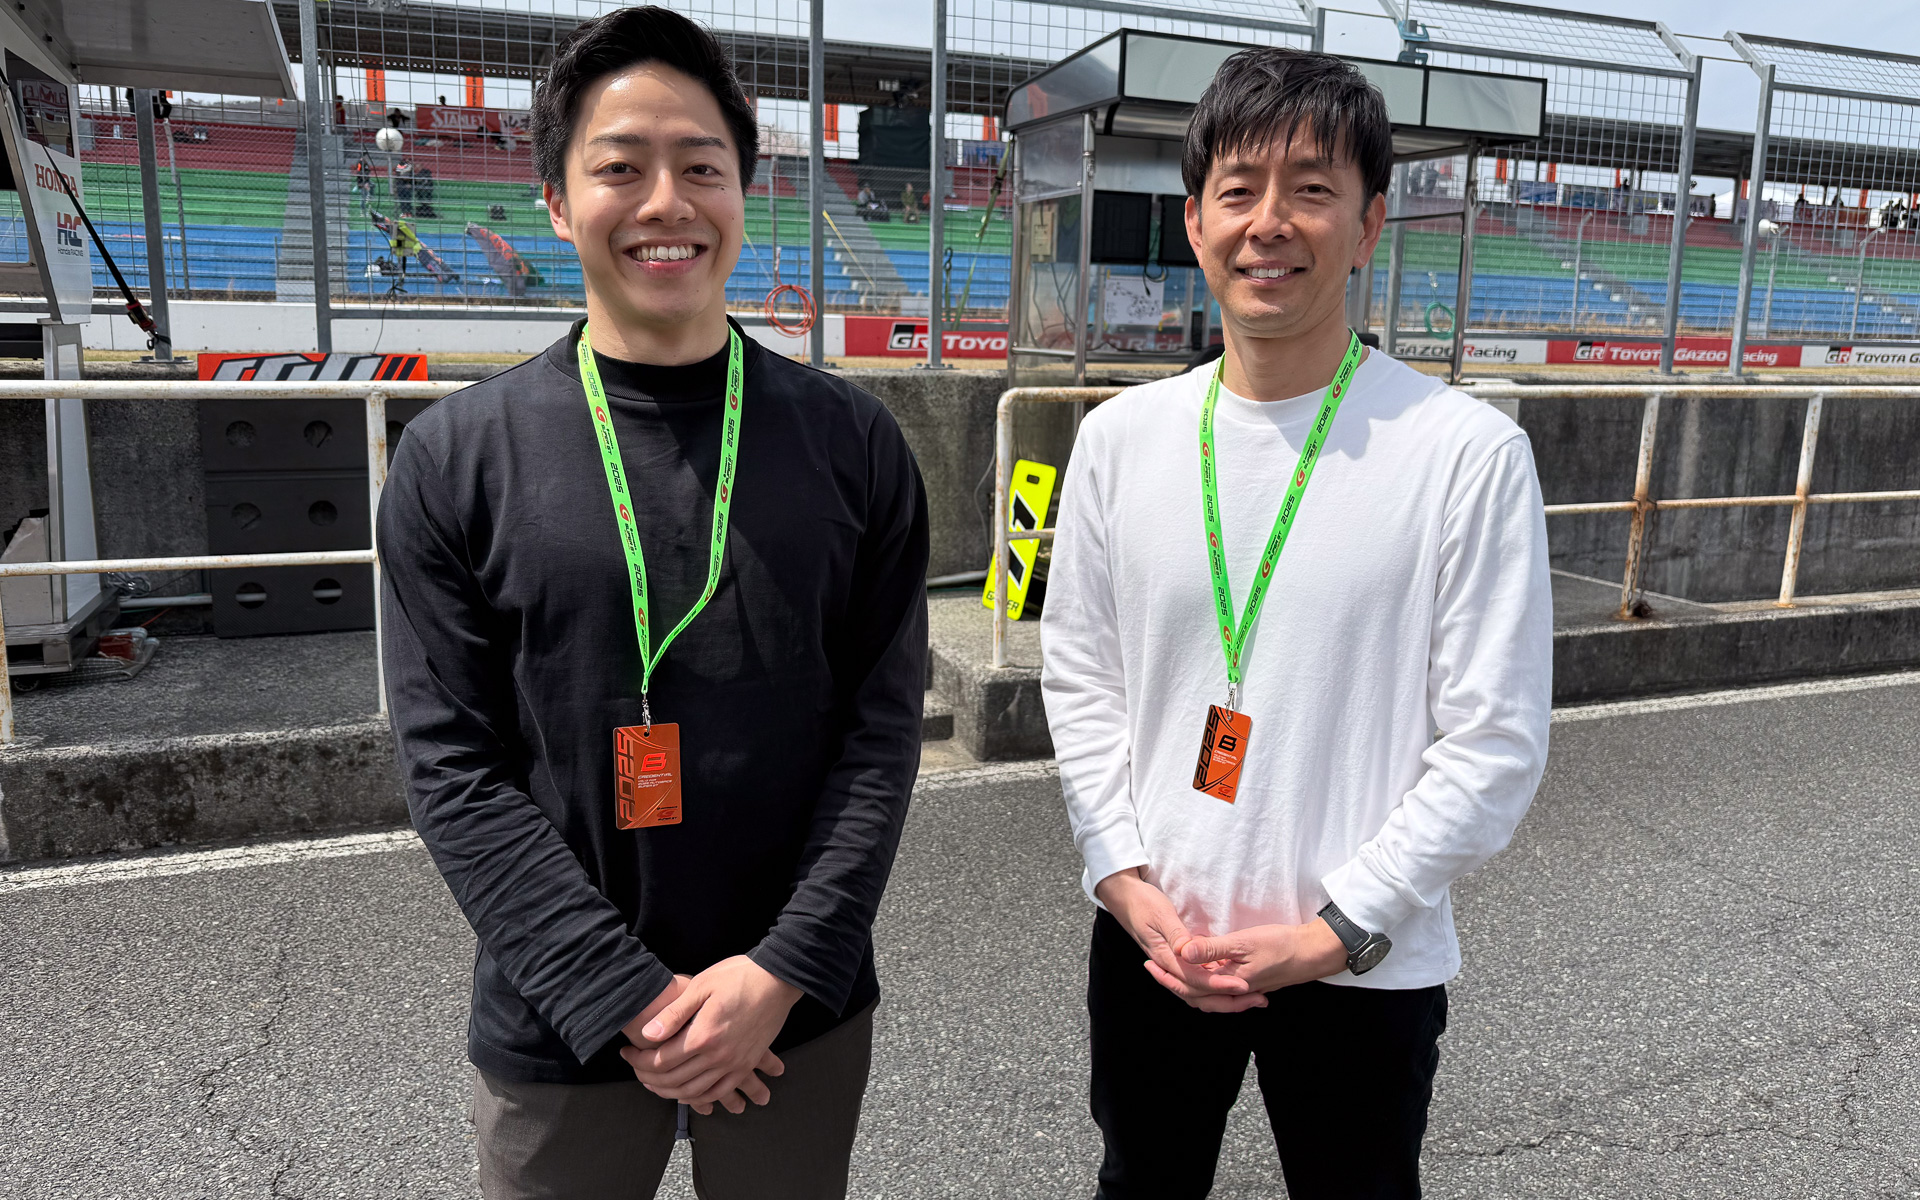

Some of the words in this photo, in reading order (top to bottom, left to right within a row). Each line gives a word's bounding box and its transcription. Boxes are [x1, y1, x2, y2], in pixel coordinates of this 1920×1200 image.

[431, 108, 484, 127] STANLEY
[34, 163, 79, 198] HONDA
[56, 211, 82, 247] HRC
[890, 334, 928, 349] GR
[943, 335, 1007, 350] TOYO
[1463, 345, 1517, 362] Racing
[1576, 346, 1604, 360] GR
[1610, 347, 1662, 361] TOYOT
[1674, 348, 1728, 362] GAZOO
[1742, 350, 1778, 366] acing
[1828, 350, 1849, 363] GR
[1856, 352, 1906, 363] TOYOTA
[587, 371, 600, 397] 2025
[727, 418, 735, 448] 2025
[1316, 405, 1331, 434] 2025
[611, 462, 624, 494] 2025
[1207, 494, 1215, 523] 2025
[1280, 494, 1296, 525] 2025
[717, 512, 725, 544] 2025
[634, 563, 643, 598] 2025
[1218, 586, 1228, 617] 2025
[1248, 586, 1262, 615] 2025
[1197, 708, 1220, 787] 2025
[617, 733, 635, 822] 2025
